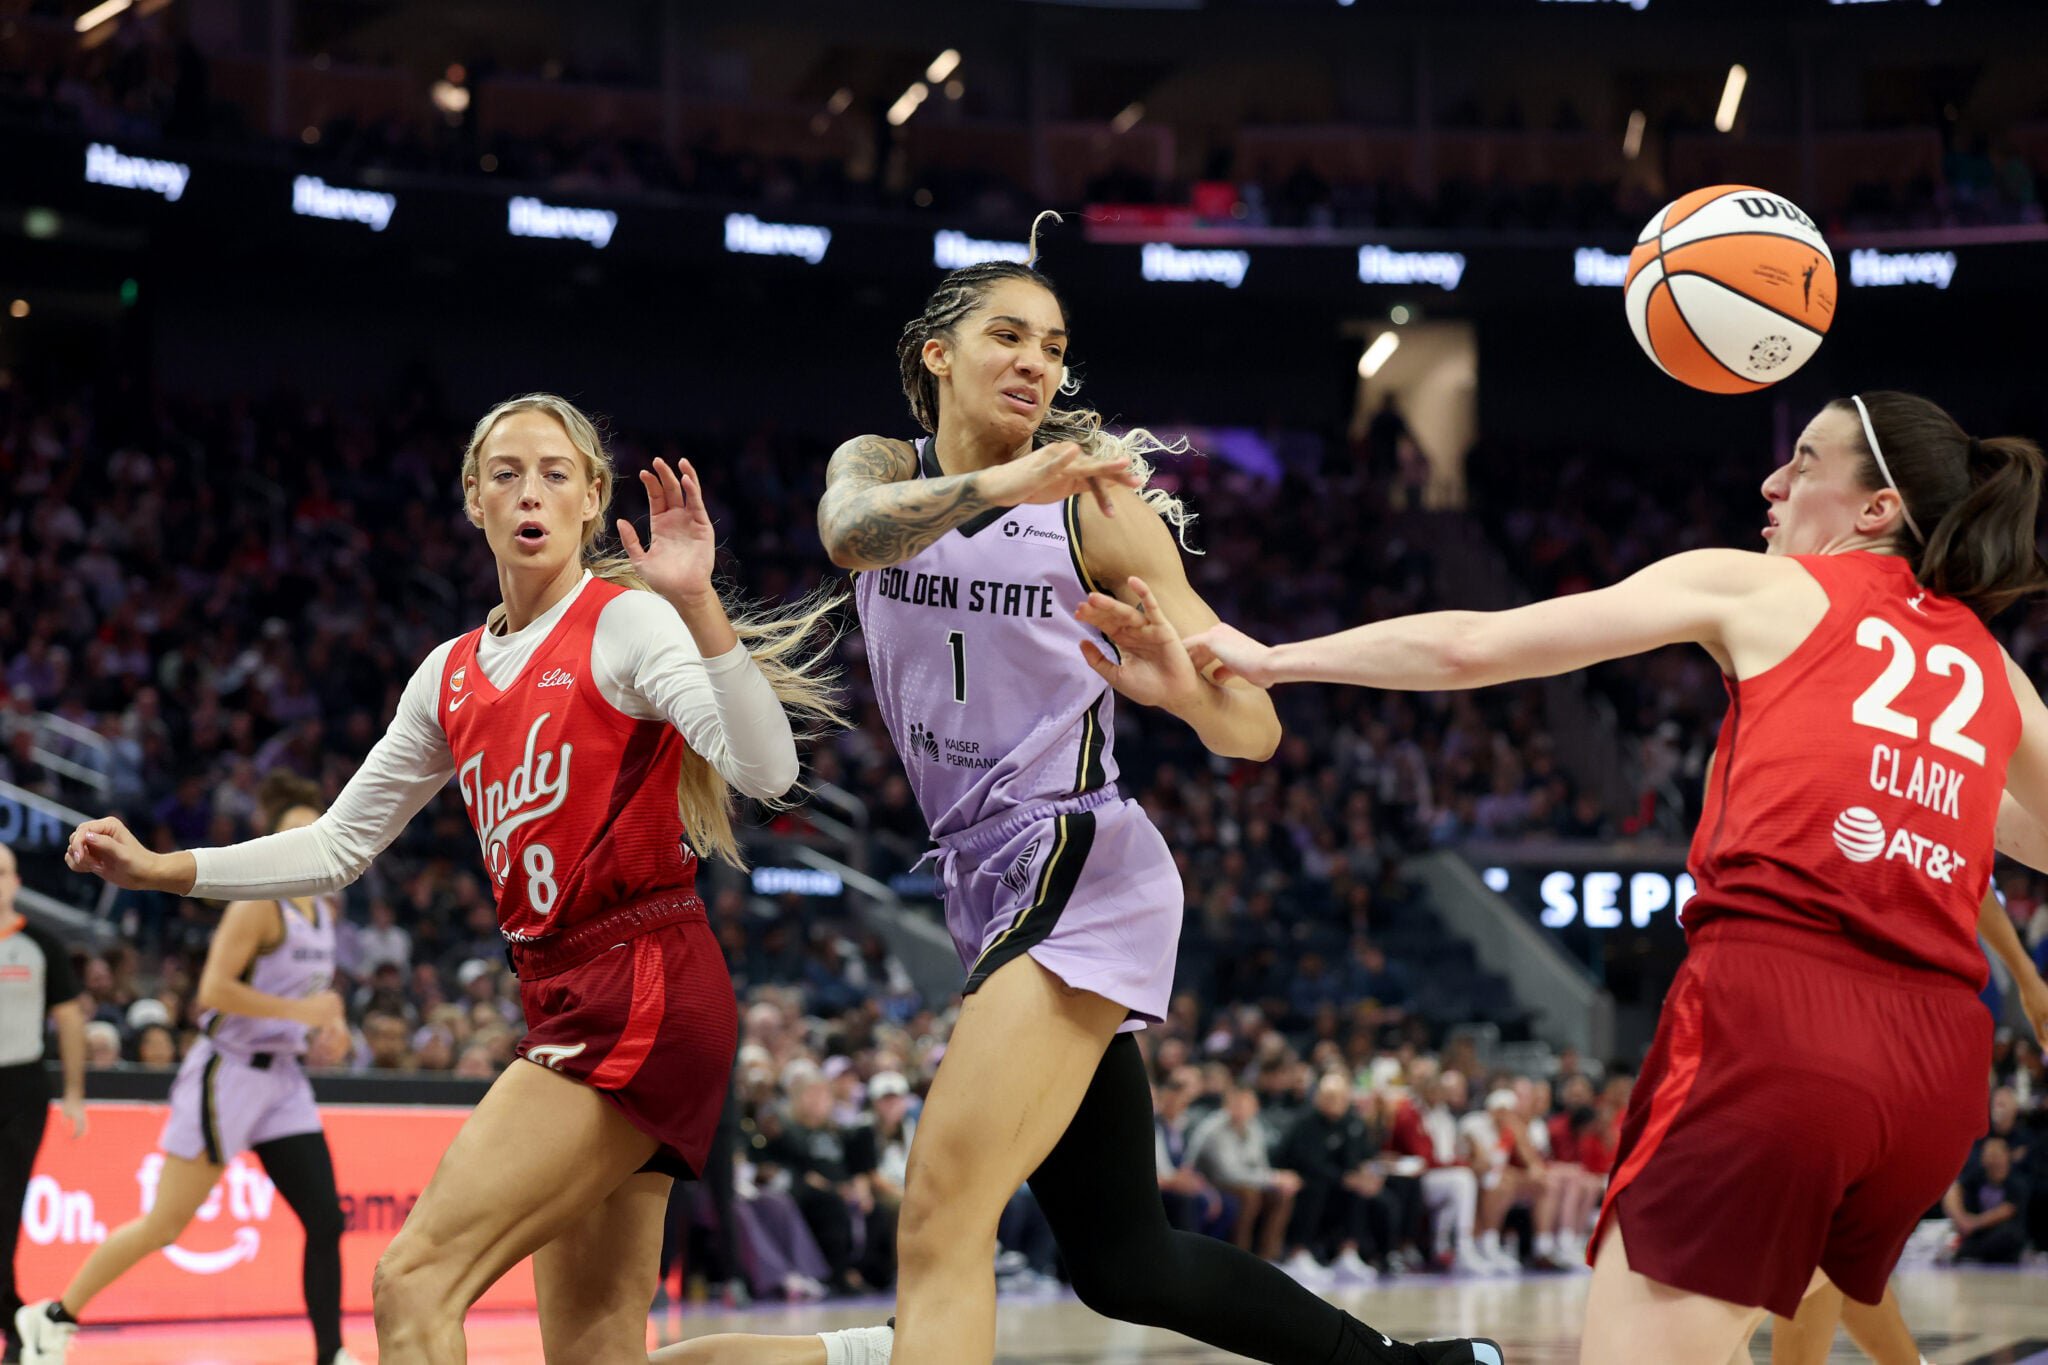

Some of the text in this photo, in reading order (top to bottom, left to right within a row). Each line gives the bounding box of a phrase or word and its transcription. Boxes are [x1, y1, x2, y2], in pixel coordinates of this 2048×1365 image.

[85, 142, 190, 201] Harvey
[292, 174, 396, 231] Harvey
[508, 196, 617, 248] Harvey
[724, 213, 831, 264] Harvey
[1141, 242, 1250, 288] Harvey
[1358, 244, 1466, 290] Harvey
[1849, 247, 1957, 289] Harvey
[1022, 525, 1066, 541] freedom
[879, 567, 1053, 618] GOLDEN STATE
[537, 668, 575, 690] Lilly
[946, 629, 966, 704] 1
[1852, 616, 1986, 767] 22
[945, 738, 980, 754] KAISER
[459, 711, 573, 860] Indy
[1870, 743, 1964, 820] CLARK
[522, 843, 558, 916] 8
[1885, 828, 1966, 884] AT&T
[22, 1175, 107, 1244] On.
